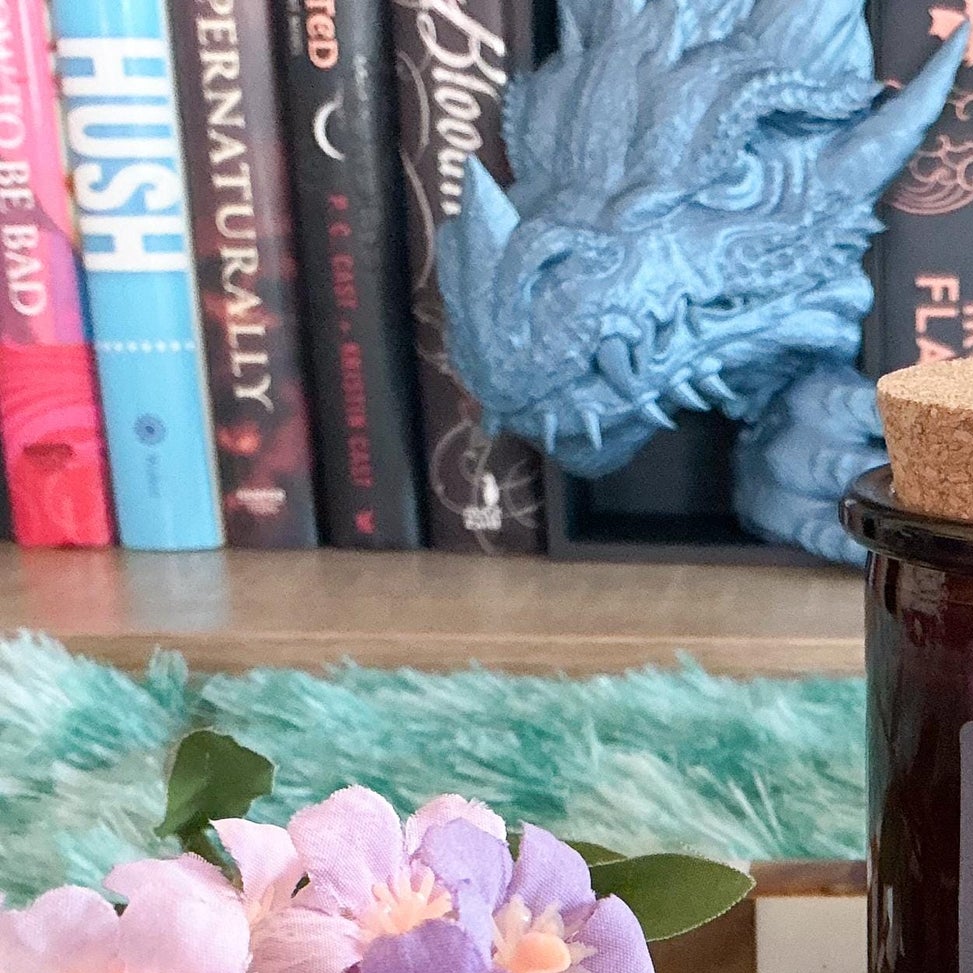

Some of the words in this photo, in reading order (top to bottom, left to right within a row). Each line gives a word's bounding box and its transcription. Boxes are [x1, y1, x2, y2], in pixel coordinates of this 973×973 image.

[0, 160, 36, 210] BE
[55, 38, 189, 272] HUSH
[3, 223, 48, 317] BAD
